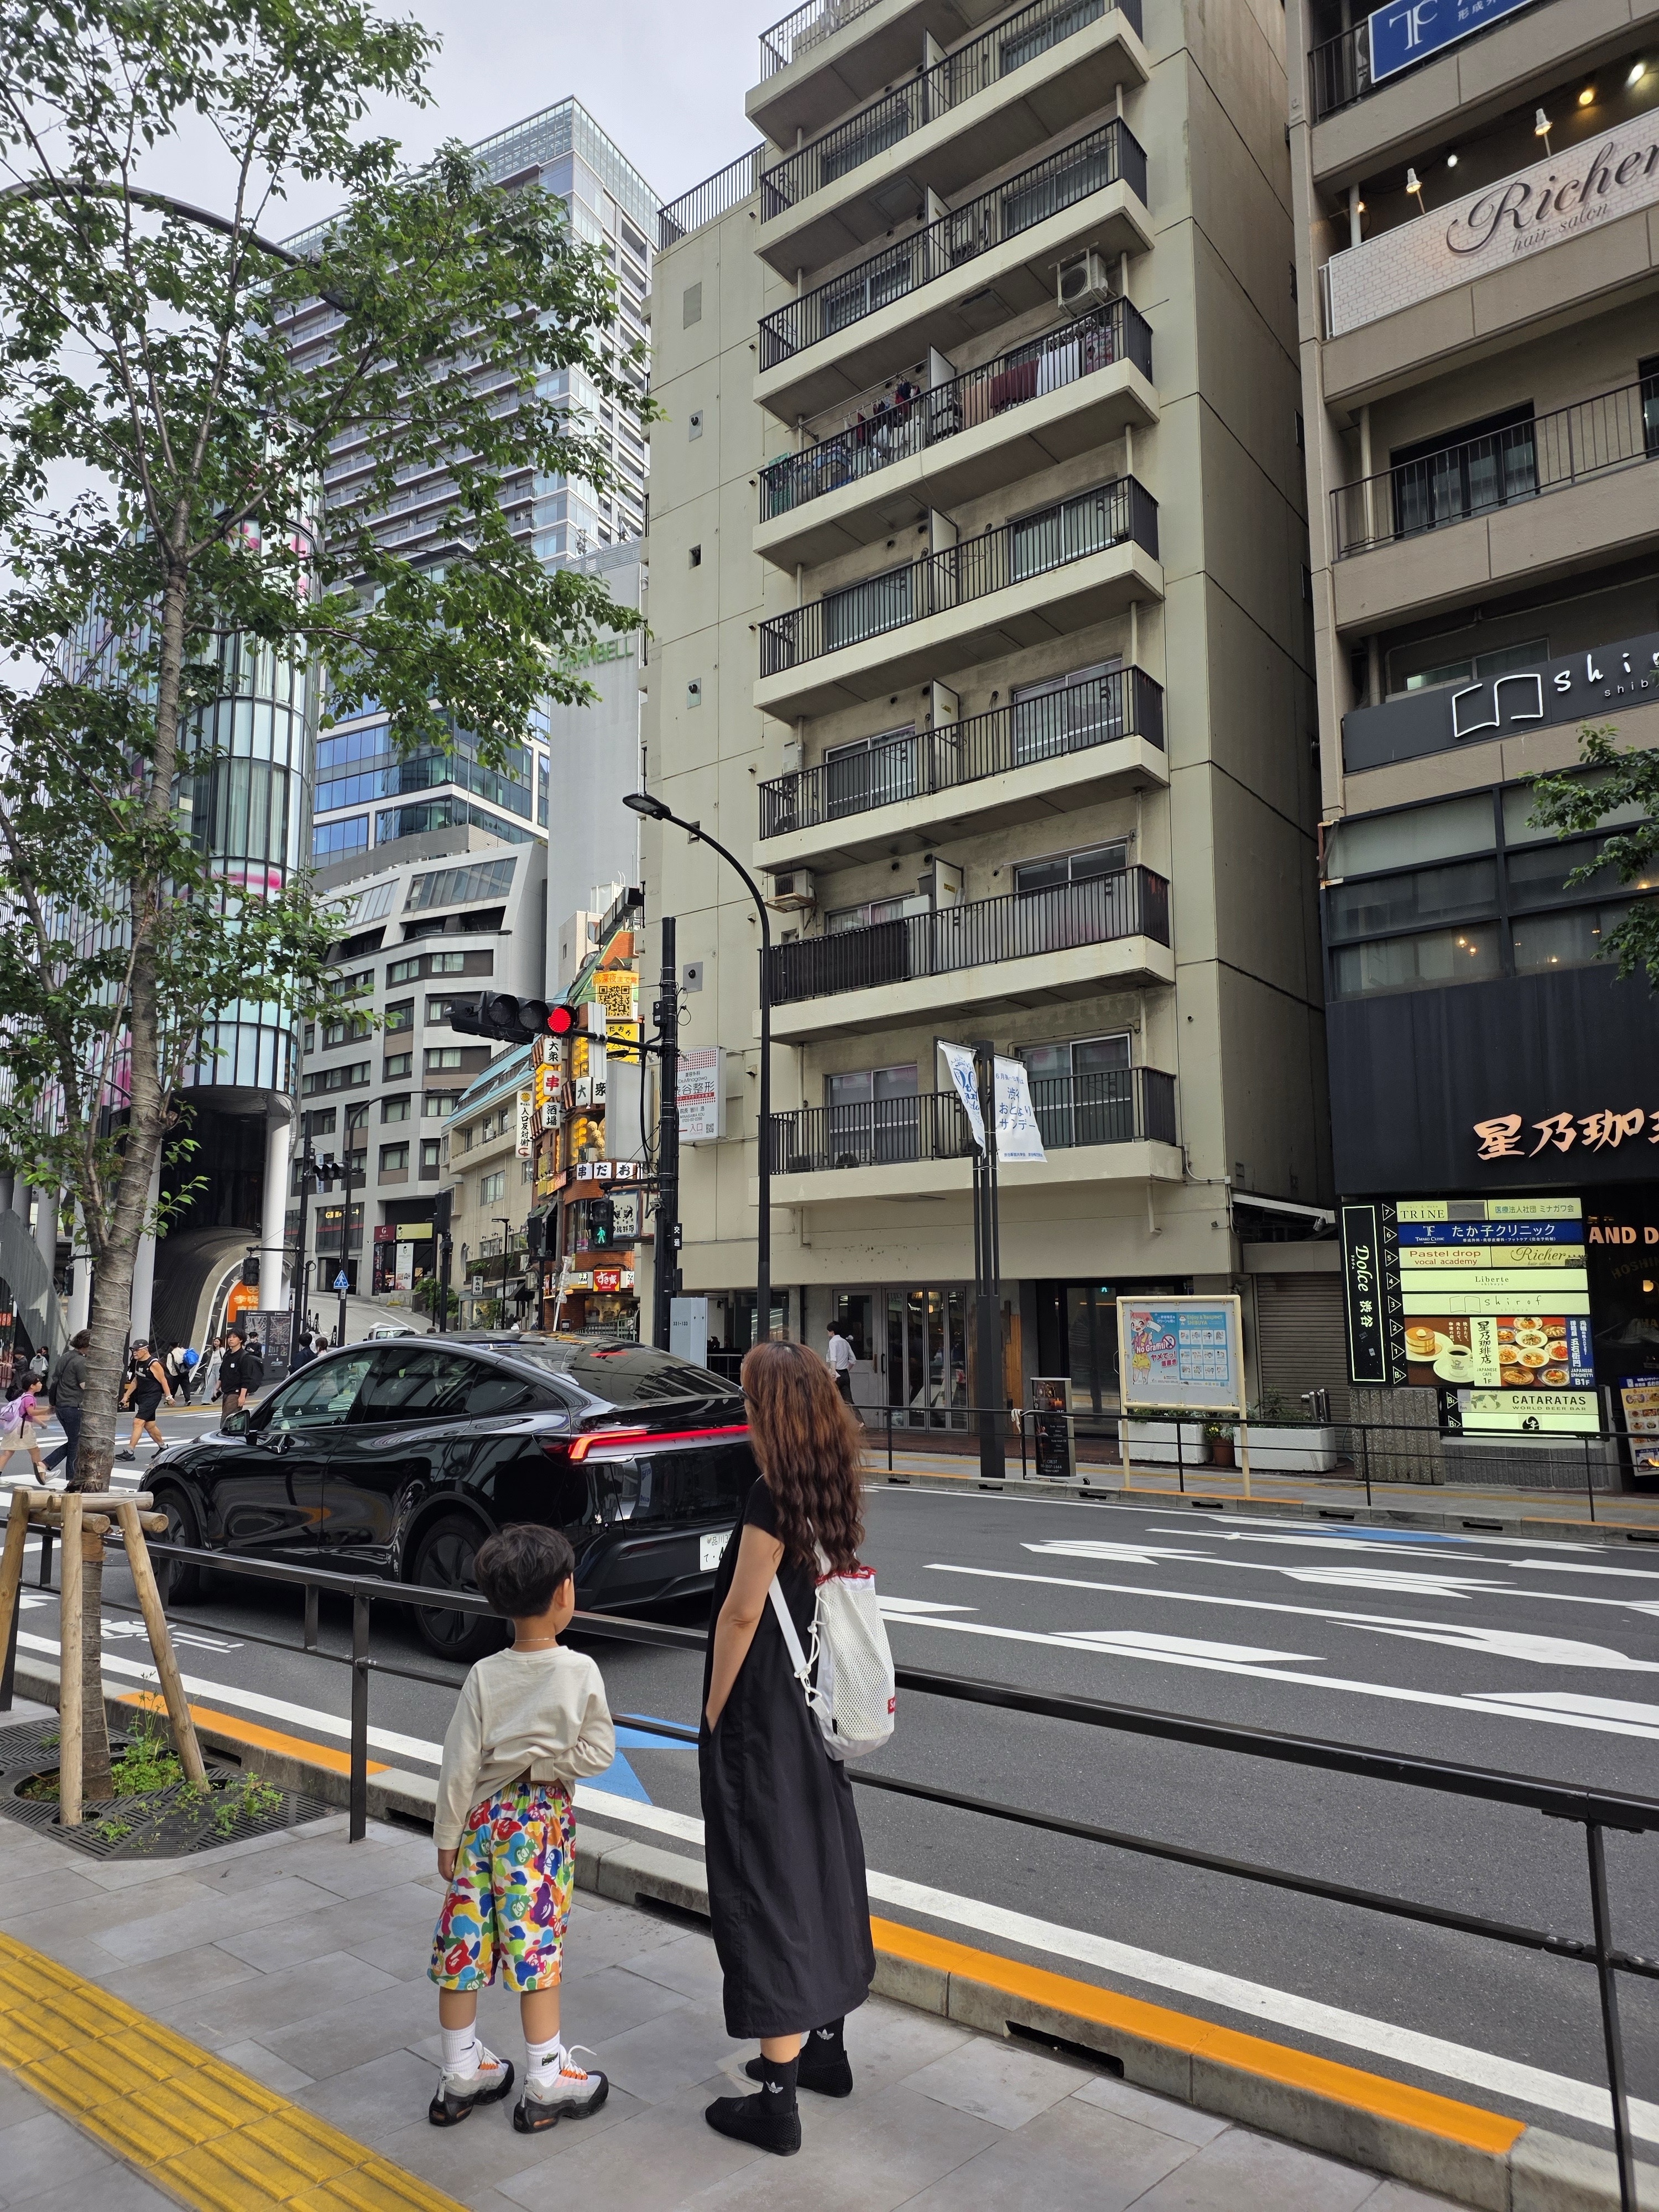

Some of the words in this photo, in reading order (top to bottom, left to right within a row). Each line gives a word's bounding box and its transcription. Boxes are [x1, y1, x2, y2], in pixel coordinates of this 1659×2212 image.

[1512, 227, 1551, 253] hair
[1558, 202, 1608, 233] salon
[548, 1041, 559, 1062] 大衆
[546, 1075, 560, 1092] 串
[546, 1104, 557, 1126] 酒場
[520, 1108, 529, 1147] 入口反対側
[690, 1123, 703, 1132] 入口
[999, 1119, 1036, 1130] サンデー
[1400, 1209, 1445, 1219] TRINE
[1495, 1206, 1537, 1214] 医療法人社団
[1540, 1204, 1575, 1213] ミナガワ会
[674, 1225, 681, 1247] 交通
[1452, 1224, 1555, 1238] たか子クリニック
[1589, 1227, 1637, 1244] AND
[1452, 1250, 1481, 1259] drop
[1510, 1246, 1566, 1261] Richer
[1355, 1245, 1373, 1292] Dolce
[596, 1272, 617, 1286] すき家
[1359, 1300, 1373, 1328] 渋谷
[1136, 1345, 1145, 1354] No
[1145, 1341, 1166, 1353] Graffiti
[1477, 1321, 1492, 1366] 星乃珈琲店
[1512, 1395, 1586, 1405] CATARATAS
[712, 1535, 724, 1546] 品川
